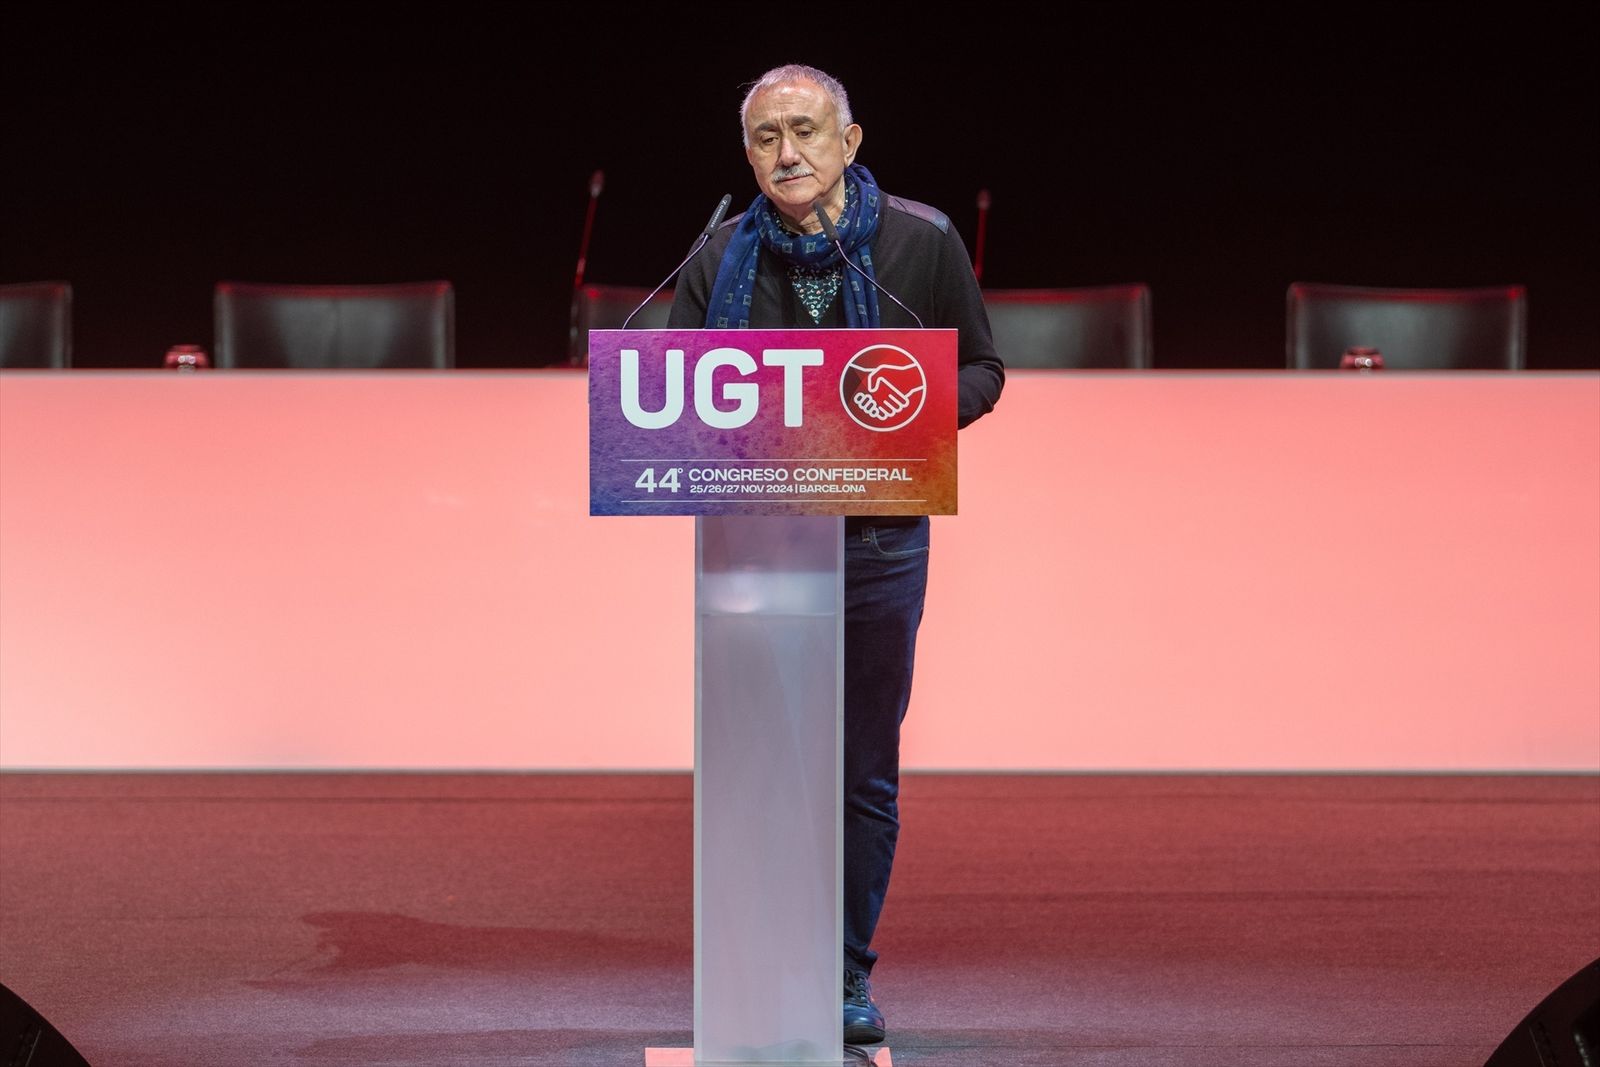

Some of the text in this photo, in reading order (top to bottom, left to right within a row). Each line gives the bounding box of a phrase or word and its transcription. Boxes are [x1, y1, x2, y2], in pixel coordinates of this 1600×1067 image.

[620, 348, 824, 430] UGT
[688, 467, 788, 482] CONGRESO
[793, 467, 912, 482] CONFEDERAL
[689, 484, 739, 494] 25/26/27
[741, 484, 765, 494] NOV
[766, 484, 793, 494] 2024
[799, 484, 866, 494] BARCELONA
